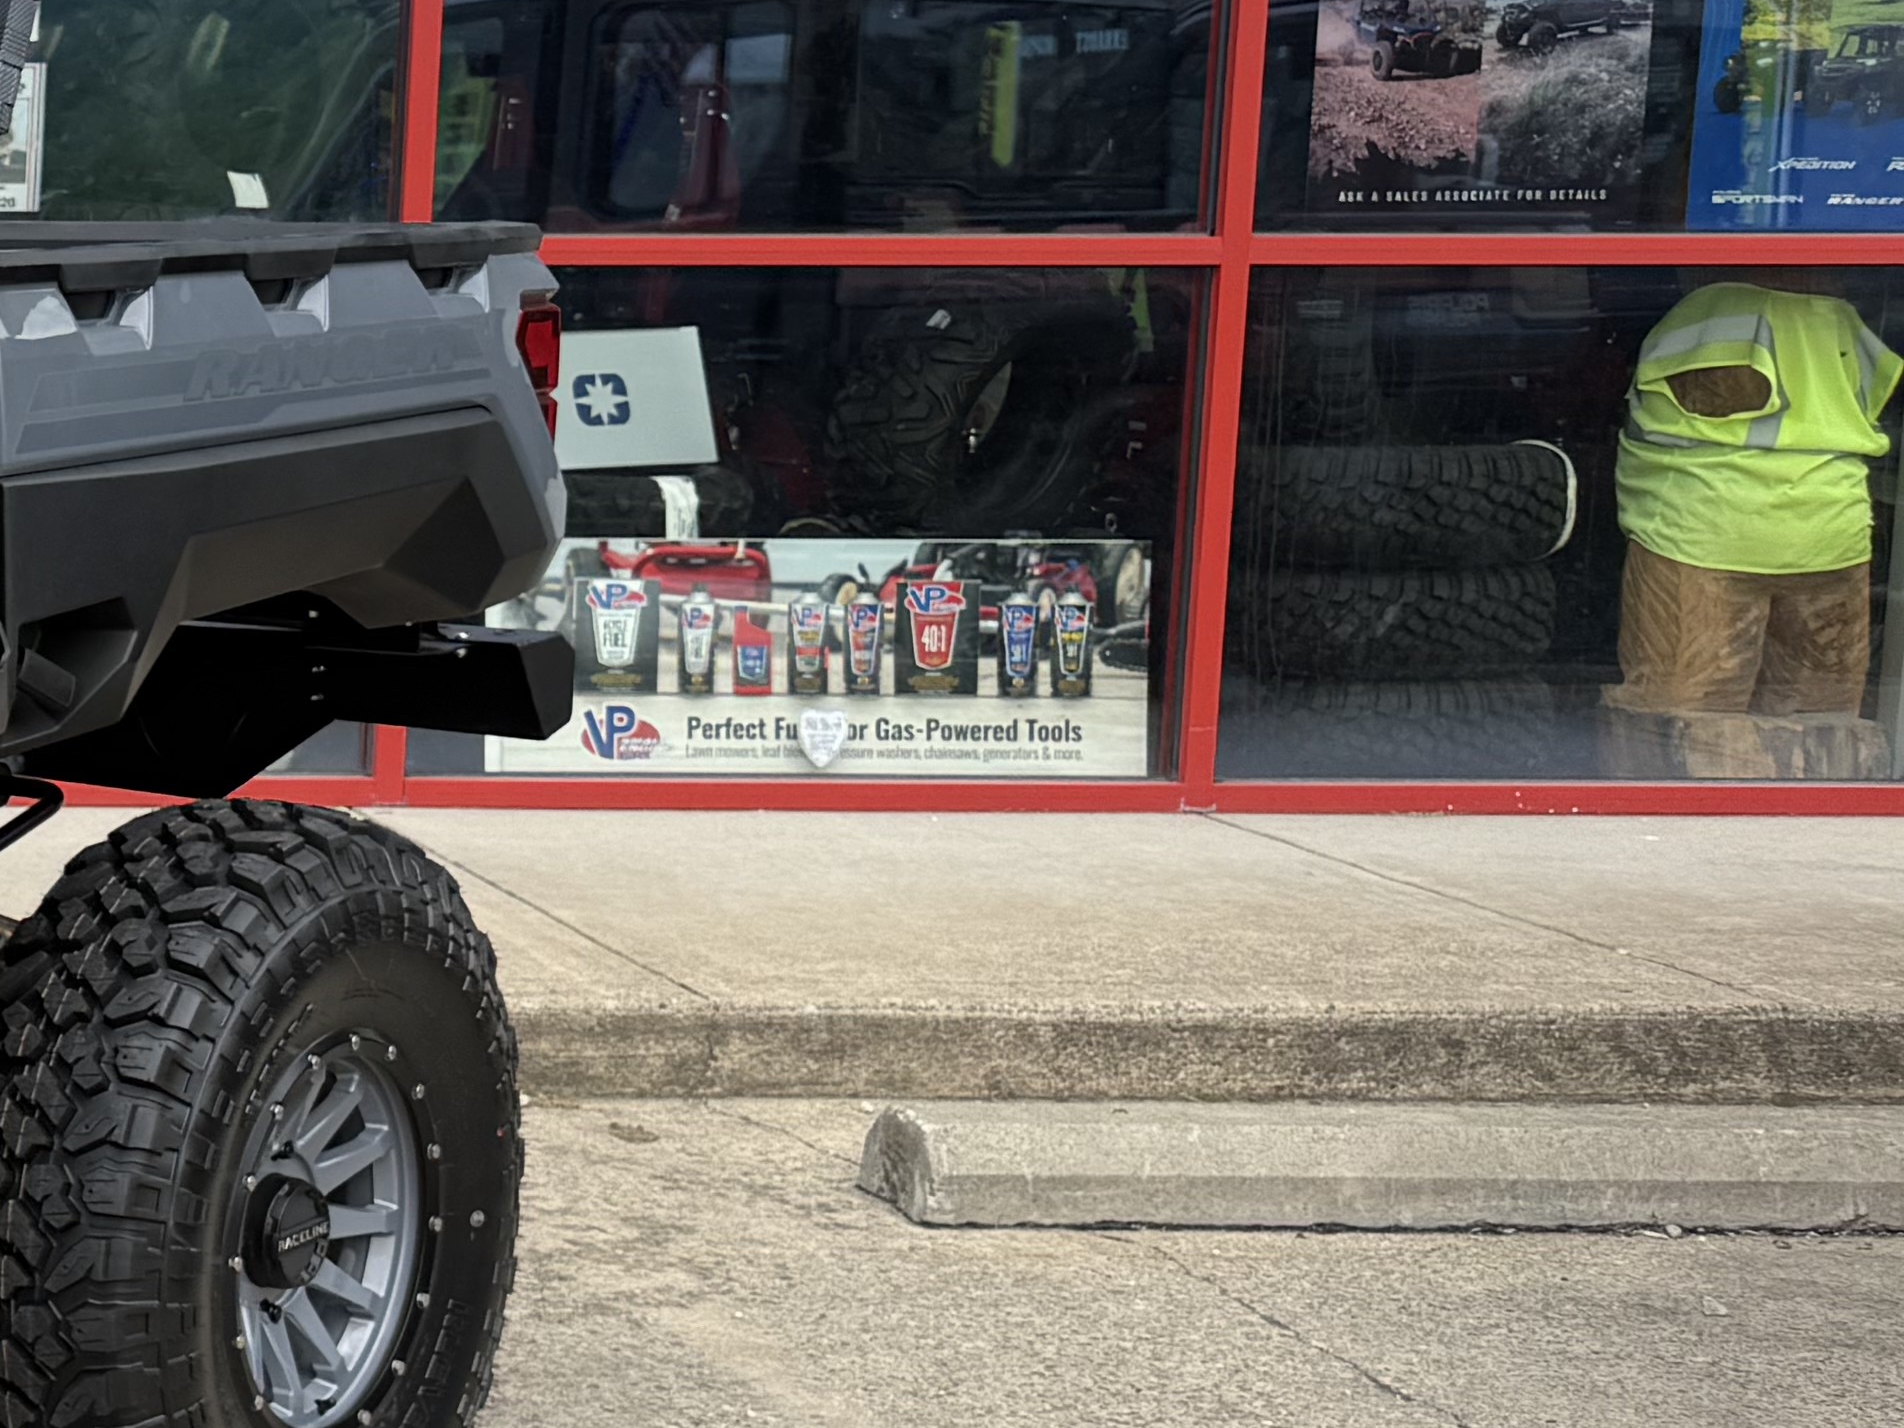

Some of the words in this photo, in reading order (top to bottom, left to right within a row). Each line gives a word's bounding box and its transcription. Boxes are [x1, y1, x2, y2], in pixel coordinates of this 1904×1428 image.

[1338, 191, 1364, 203] ASK
[1371, 191, 1380, 203] A
[1386, 190, 1428, 203] SALES
[1435, 189, 1509, 202] ASSOCIATE
[1517, 189, 1543, 202] FOR
[921, 625, 947, 652] 40:1
[583, 705, 636, 760] VP
[686, 716, 767, 740] Perfect
[775, 717, 798, 740] Fu
[848, 722, 869, 741] or
[876, 717, 1018, 742] Gas-Powered
[1025, 718, 1083, 743] Tools
[686, 745, 713, 759] Lawn
[761, 745, 781, 759] leaf
[876, 745, 921, 760] washers,
[983, 746, 1039, 762] generators
[1042, 746, 1050, 759] &
